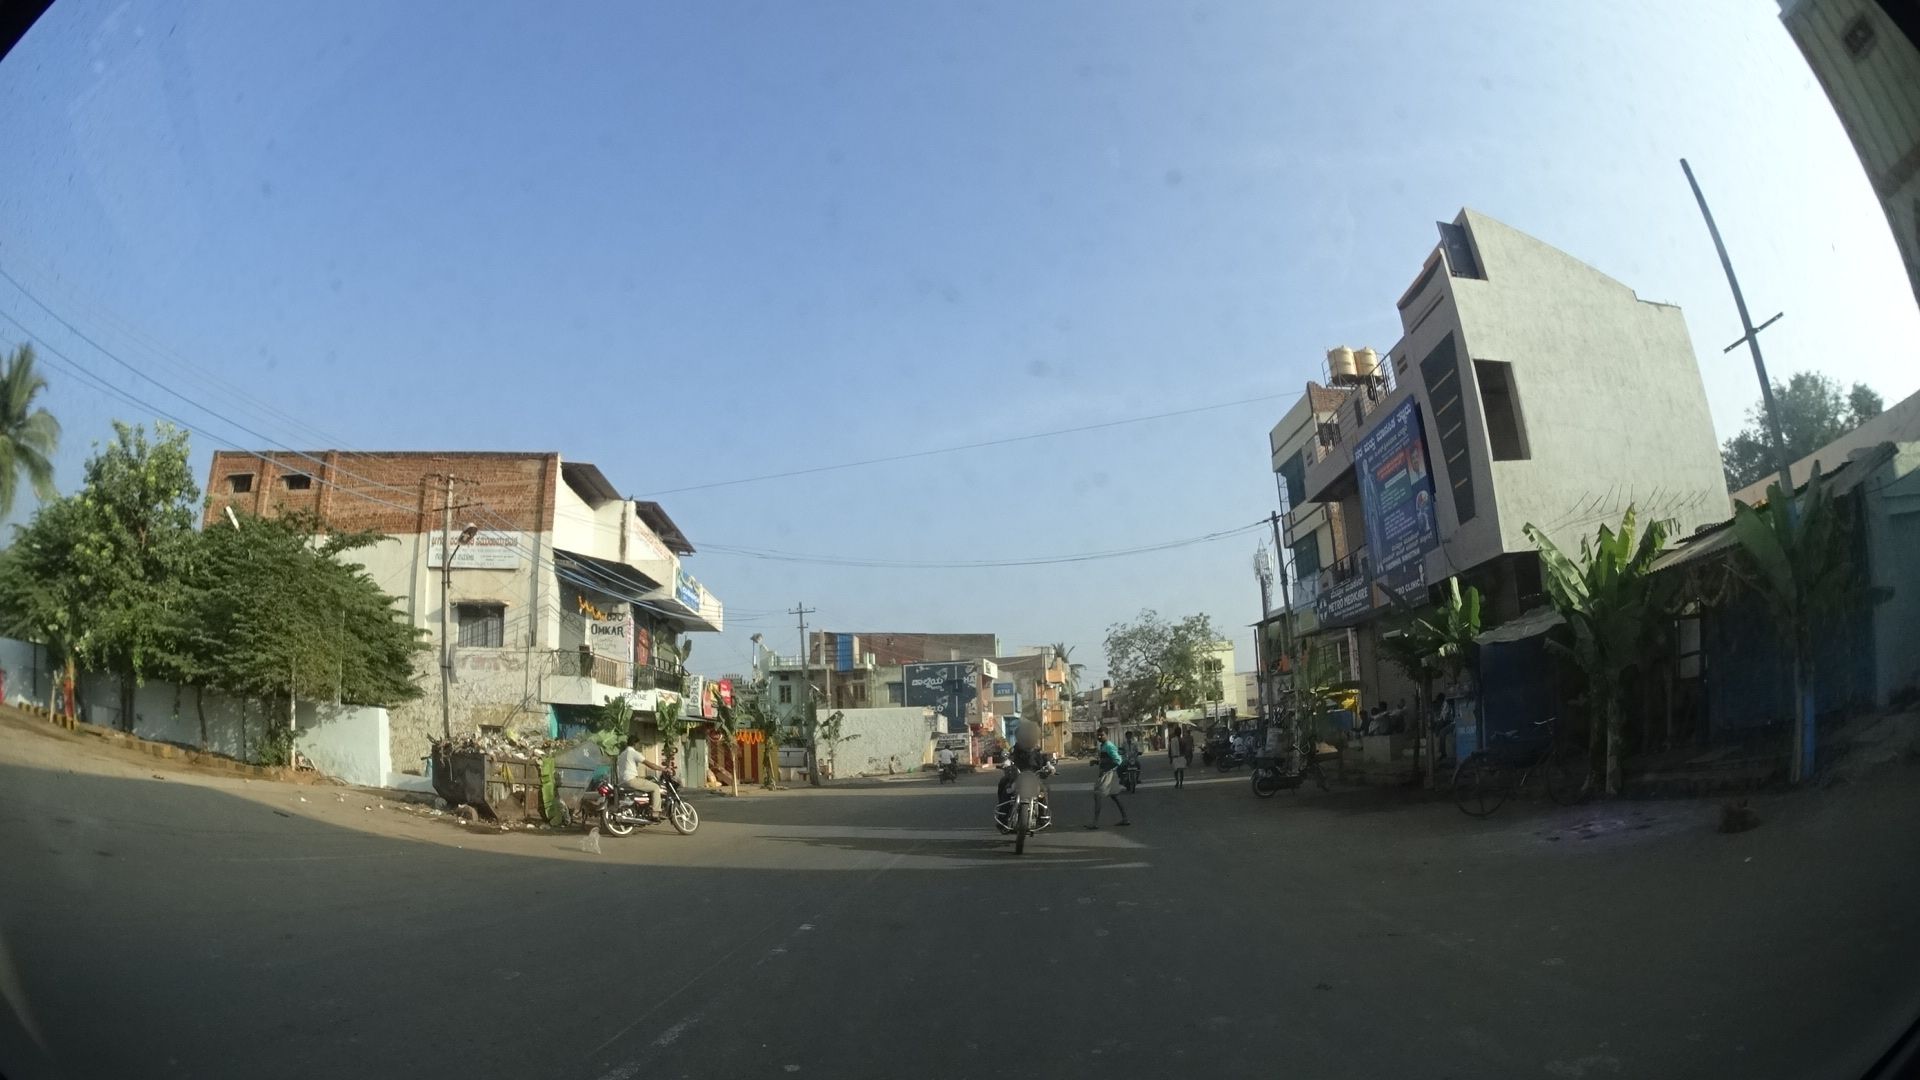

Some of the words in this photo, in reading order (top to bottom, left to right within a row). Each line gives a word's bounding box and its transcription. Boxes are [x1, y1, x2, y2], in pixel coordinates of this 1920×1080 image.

[1328, 597, 1344, 613] METRO
[1343, 586, 1369, 606] MEDICARE
[591, 623, 625, 638] OMKAR
